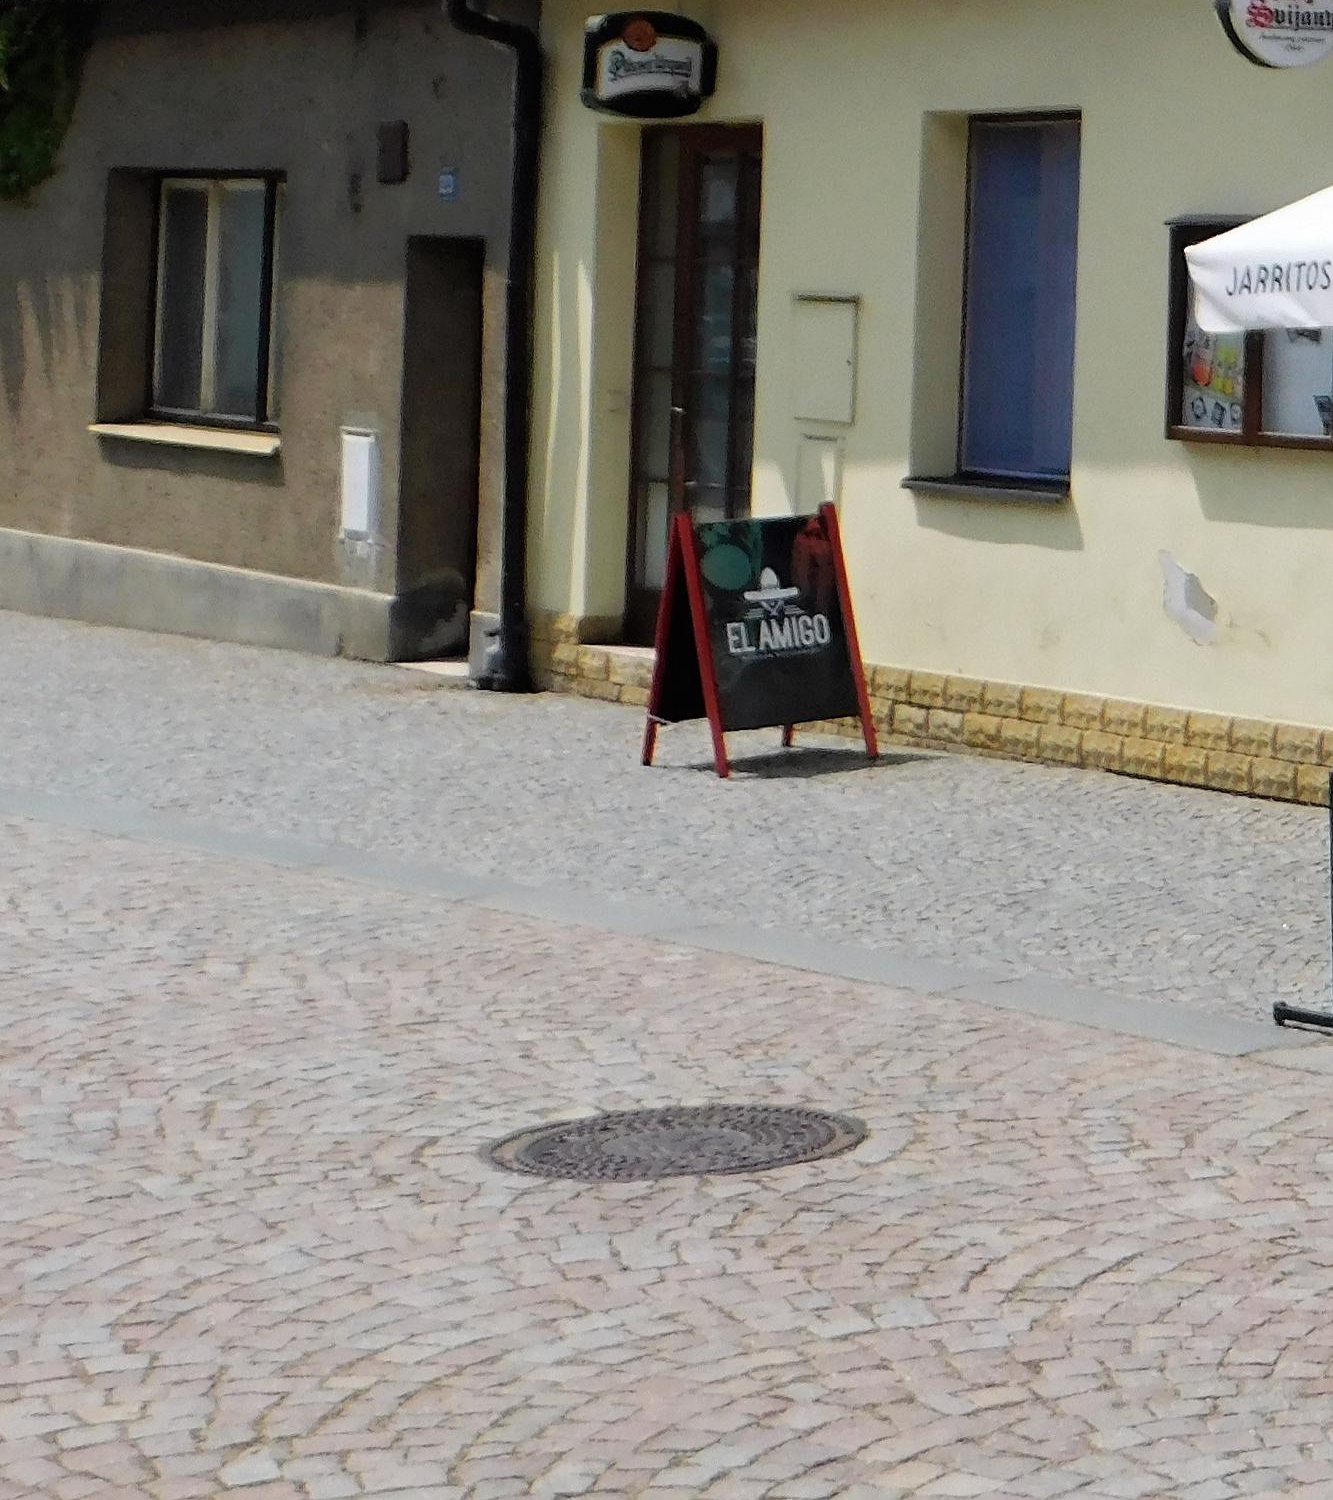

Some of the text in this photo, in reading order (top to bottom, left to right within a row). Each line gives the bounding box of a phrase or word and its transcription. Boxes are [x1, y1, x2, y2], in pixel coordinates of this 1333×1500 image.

[1225, 260, 1332, 296] JARRITOS
[727, 613, 831, 653] EL AMIGO
